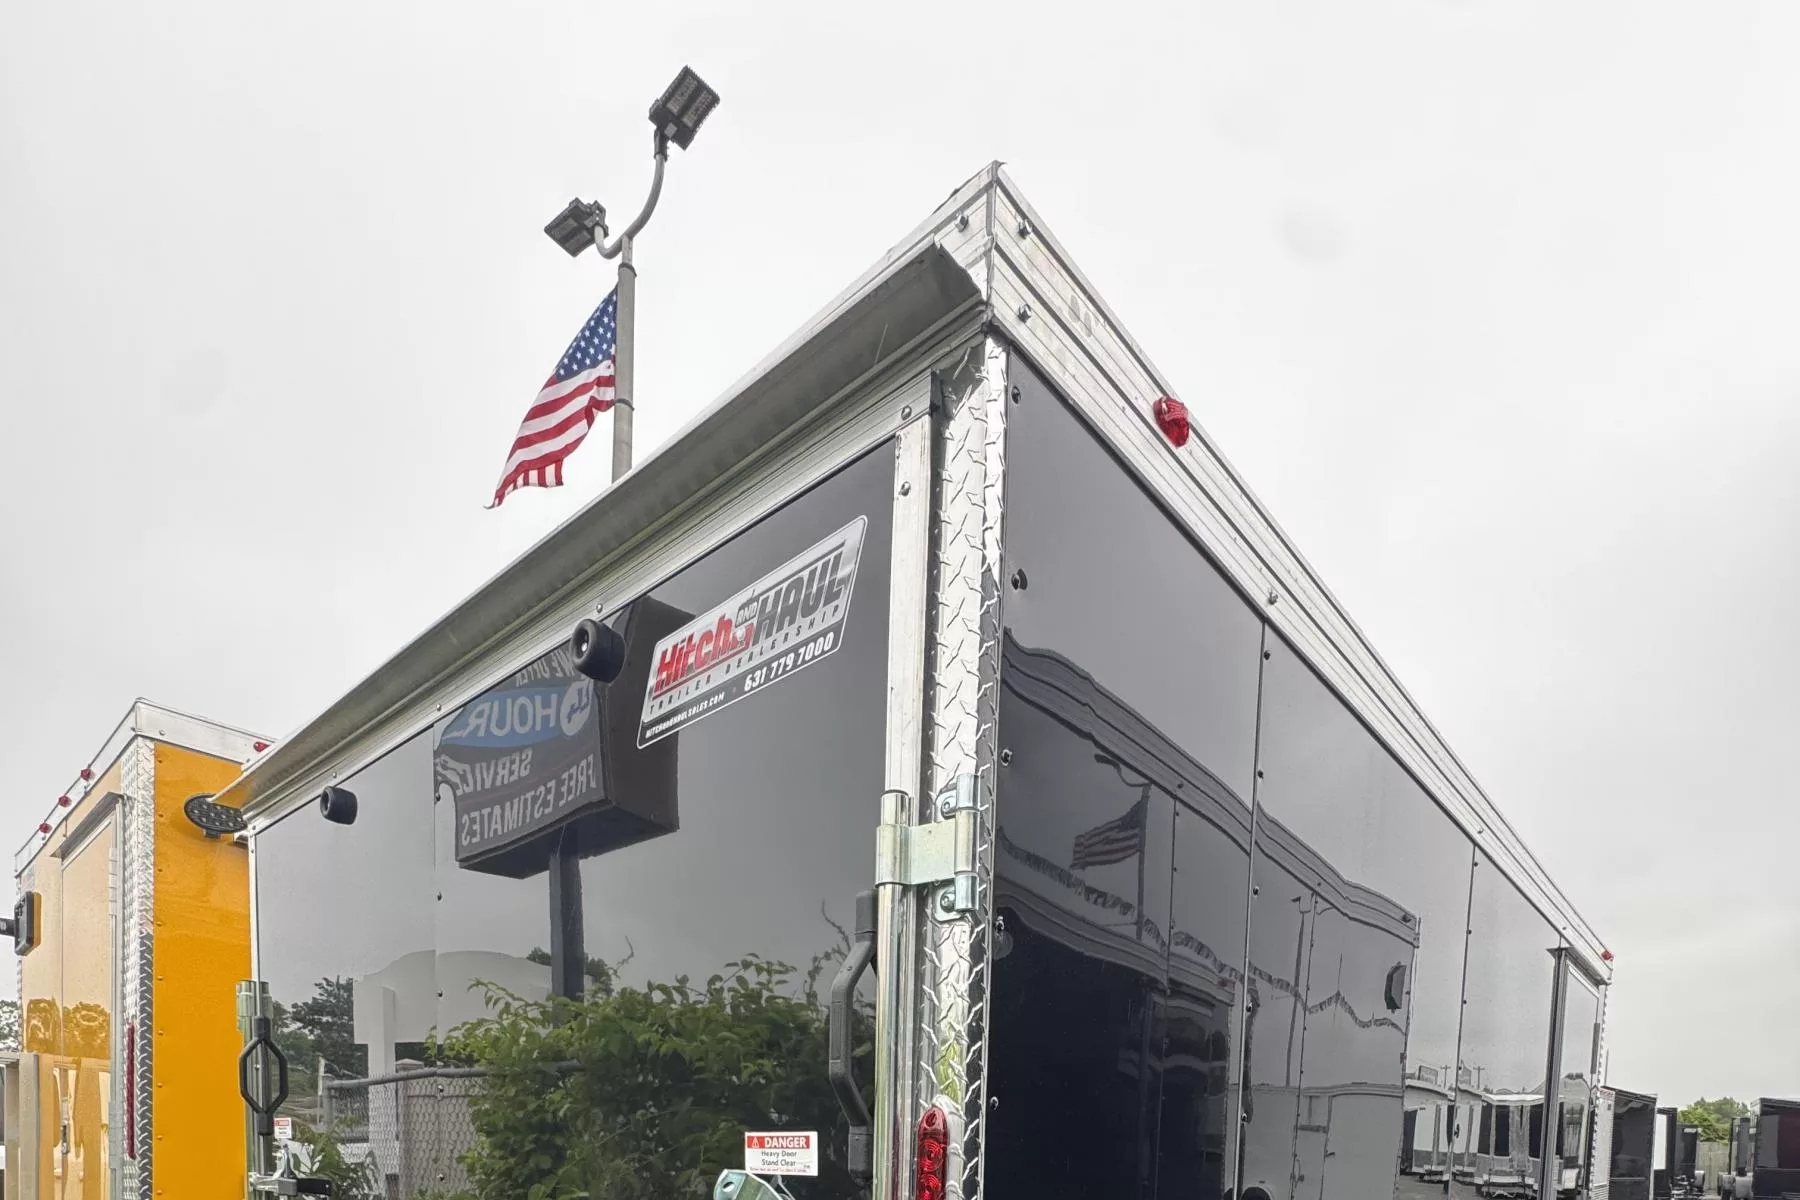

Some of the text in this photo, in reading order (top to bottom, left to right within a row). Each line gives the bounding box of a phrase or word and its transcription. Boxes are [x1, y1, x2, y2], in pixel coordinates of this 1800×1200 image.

[752, 551, 850, 647] HAUL
[650, 674, 712, 714] TRAILER
[725, 604, 839, 675] DEALERSHIP
[744, 667, 767, 692] 631
[770, 653, 796, 680] 779
[797, 631, 835, 665] 7000
[761, 1151, 780, 1159] Heavy
[765, 1136, 807, 1148] DANGER
[761, 1159, 779, 1167] Stand
[780, 1159, 796, 1167] Clear
